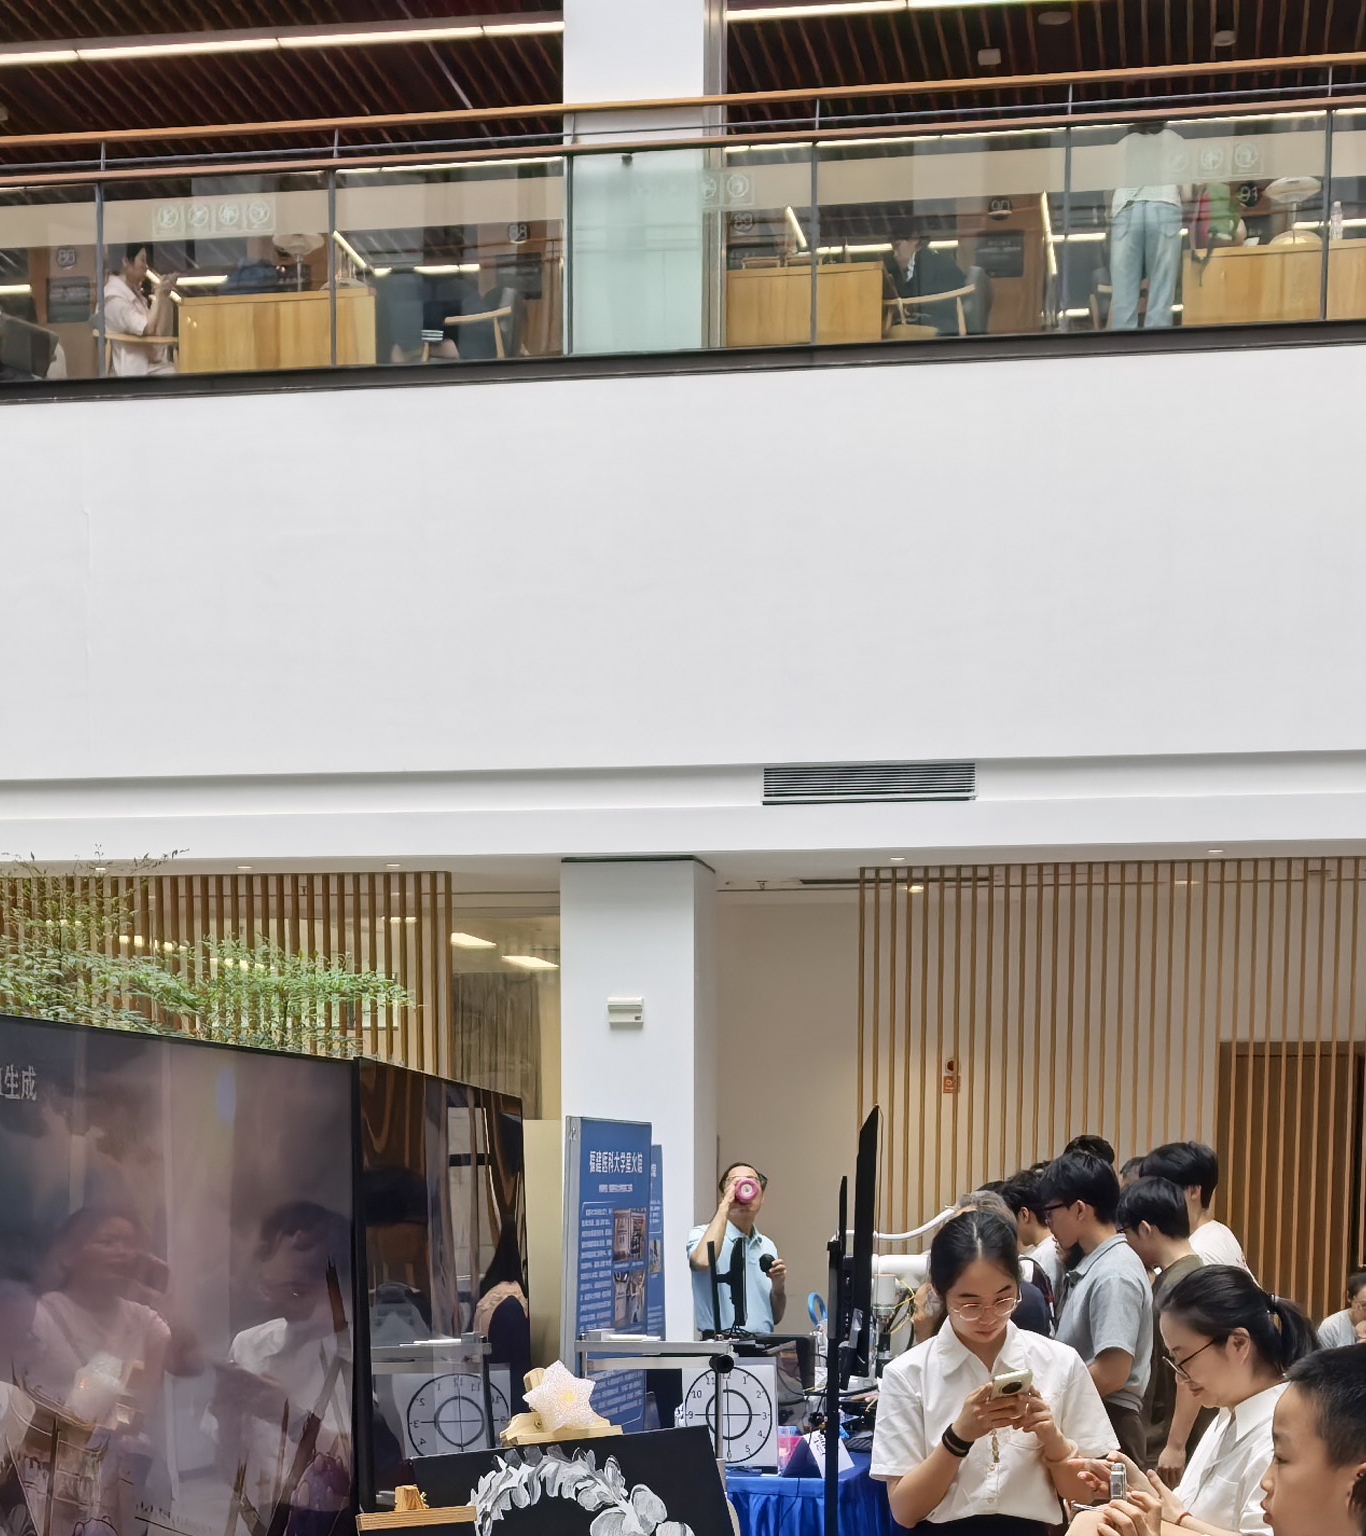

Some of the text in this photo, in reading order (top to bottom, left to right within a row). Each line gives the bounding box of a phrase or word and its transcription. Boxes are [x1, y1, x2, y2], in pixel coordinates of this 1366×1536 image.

[692, 1390, 702, 1399] 10
[756, 1390, 762, 1399] 2
[688, 1410, 694, 1419] 9
[762, 1412, 767, 1420] 3
[757, 1430, 763, 1438] 4
[745, 1444, 751, 1453] 5
